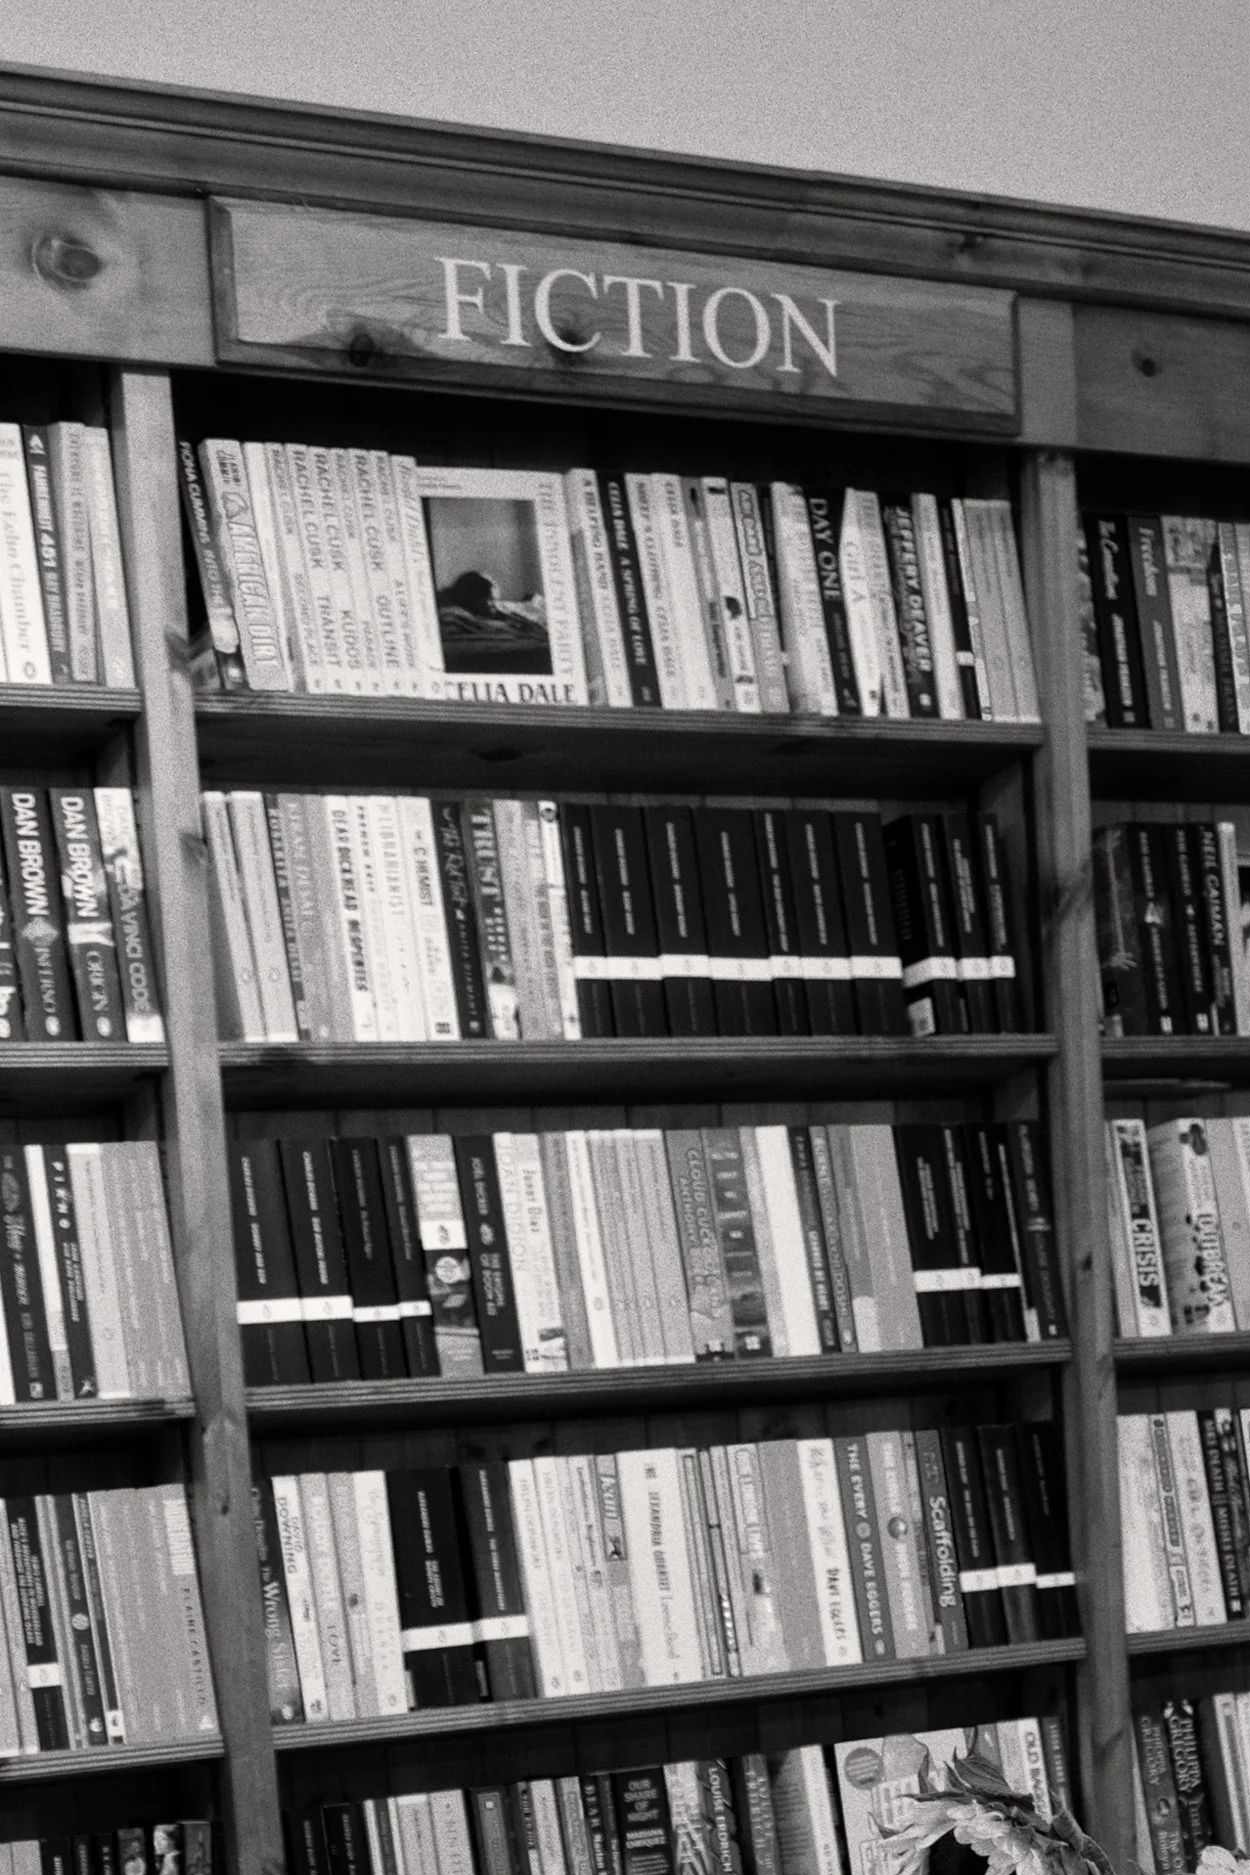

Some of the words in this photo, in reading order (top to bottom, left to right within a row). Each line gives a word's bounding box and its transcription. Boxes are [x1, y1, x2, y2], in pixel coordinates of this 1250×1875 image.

[434, 256, 841, 377] FICTION
[179, 441, 196, 481] FIONA
[188, 483, 212, 544] CUMMINS
[293, 449, 315, 517] RACHEL
[304, 521, 323, 569] CUSK
[314, 452, 335, 520] RACHEL
[354, 453, 377, 520] RACHEL
[367, 525, 384, 572] CUSK
[40, 533, 58, 568] 451
[324, 524, 344, 572] CUSK
[809, 496, 835, 546] DAY
[894, 506, 921, 589] JEFFERY
[817, 551, 842, 601] ONE
[842, 540, 863, 584] Girl
[8, 564, 33, 653] Chamber
[227, 522, 267, 619] AMERICAN
[249, 624, 279, 668] DIRT
[851, 588, 867, 604] A
[317, 594, 342, 668] TRANSIT
[340, 609, 361, 670] KUDOS
[376, 595, 400, 669] OUTLINE
[554, 619, 573, 677] PARTY
[907, 594, 933, 672] DEAVER
[517, 683, 578, 704] DALE
[10, 792, 39, 837] DAN
[59, 795, 87, 839] DAN
[331, 808, 350, 844] DEAR
[17, 838, 50, 917] BROWN
[68, 843, 100, 918] BROWN
[337, 846, 359, 912] DICKHEAD
[377, 816, 405, 917] LIBRARIANIST
[412, 846, 434, 908] CHEMIST
[470, 807, 501, 902] TRUST
[1201, 831, 1215, 869] NEIL
[117, 884, 140, 912] DA
[1205, 874, 1224, 946] GAIMAN
[120, 912, 147, 959] VINCI
[33, 946, 57, 1015] INFERNO
[85, 950, 110, 1013] ORIGIN
[128, 962, 151, 1013] CODE
[497, 1142, 516, 1194] JOAN
[686, 1149, 709, 1204] CLOUD
[507, 1202, 528, 1272] DIDION
[678, 1176, 697, 1244] ANTHONY
[1132, 1218, 1158, 1287] CRISIS
[1200, 1213, 1229, 1307] OUTBREAK
[846, 1442, 858, 1470] THE
[850, 1475, 867, 1519] EVERY
[1208, 1450, 1224, 1492] DEATH
[1223, 1555, 1240, 1597] DEATH
[277, 1496, 297, 1575] DOWNING
[860, 1542, 875, 1578] DAVE
[928, 1494, 957, 1609] Scaffolding
[261, 1581, 286, 1640] Wrong
[867, 1581, 884, 1636] EGGERS
[268, 1642, 291, 1692] Sister
[325, 1623, 342, 1667] LOVE
[1024, 1731, 1042, 1765] OLD
[1140, 1715, 1161, 1787] GREGORY
[1169, 1714, 1190, 1793] GREGORY
[1181, 1719, 1201, 1788] PHILIPPA
[583, 1784, 601, 1829] BEAR
[708, 1766, 723, 1814] LOUISE
[715, 1815, 732, 1873] ERDRICH
